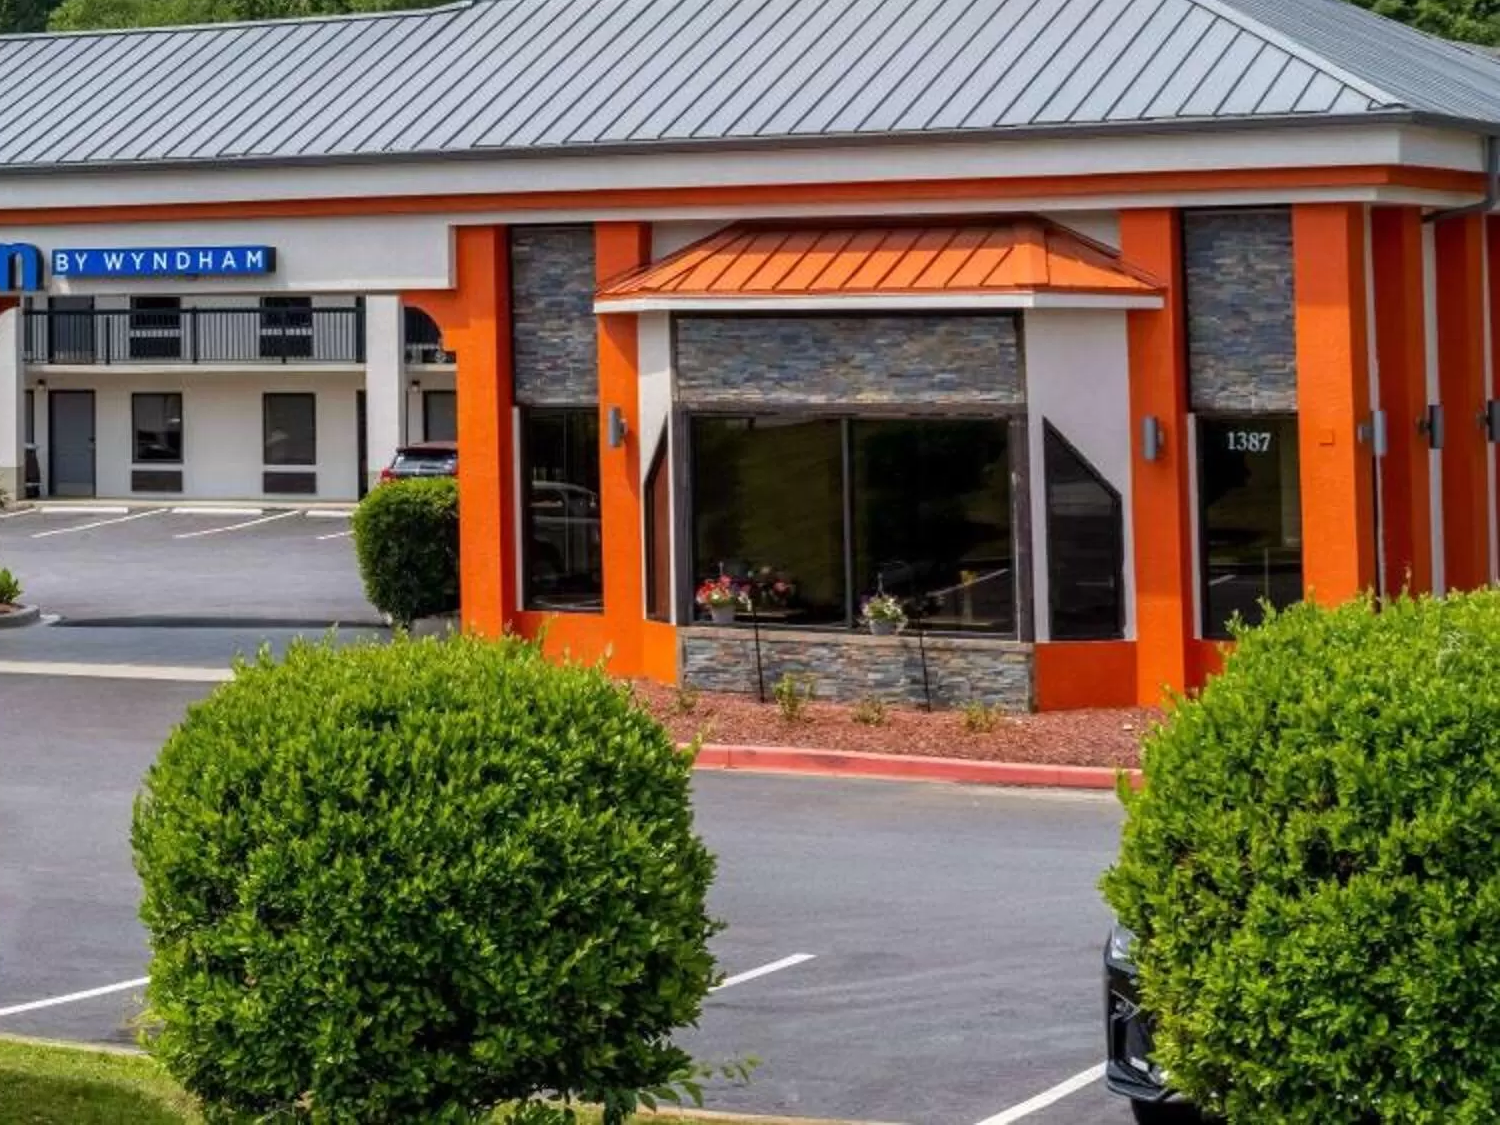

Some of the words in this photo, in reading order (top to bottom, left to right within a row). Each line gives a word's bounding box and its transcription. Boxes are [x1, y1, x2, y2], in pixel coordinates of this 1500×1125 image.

[55, 252, 88, 272] BY
[103, 250, 264, 272] WYNDHAM
[1226, 431, 1271, 452] 1387
